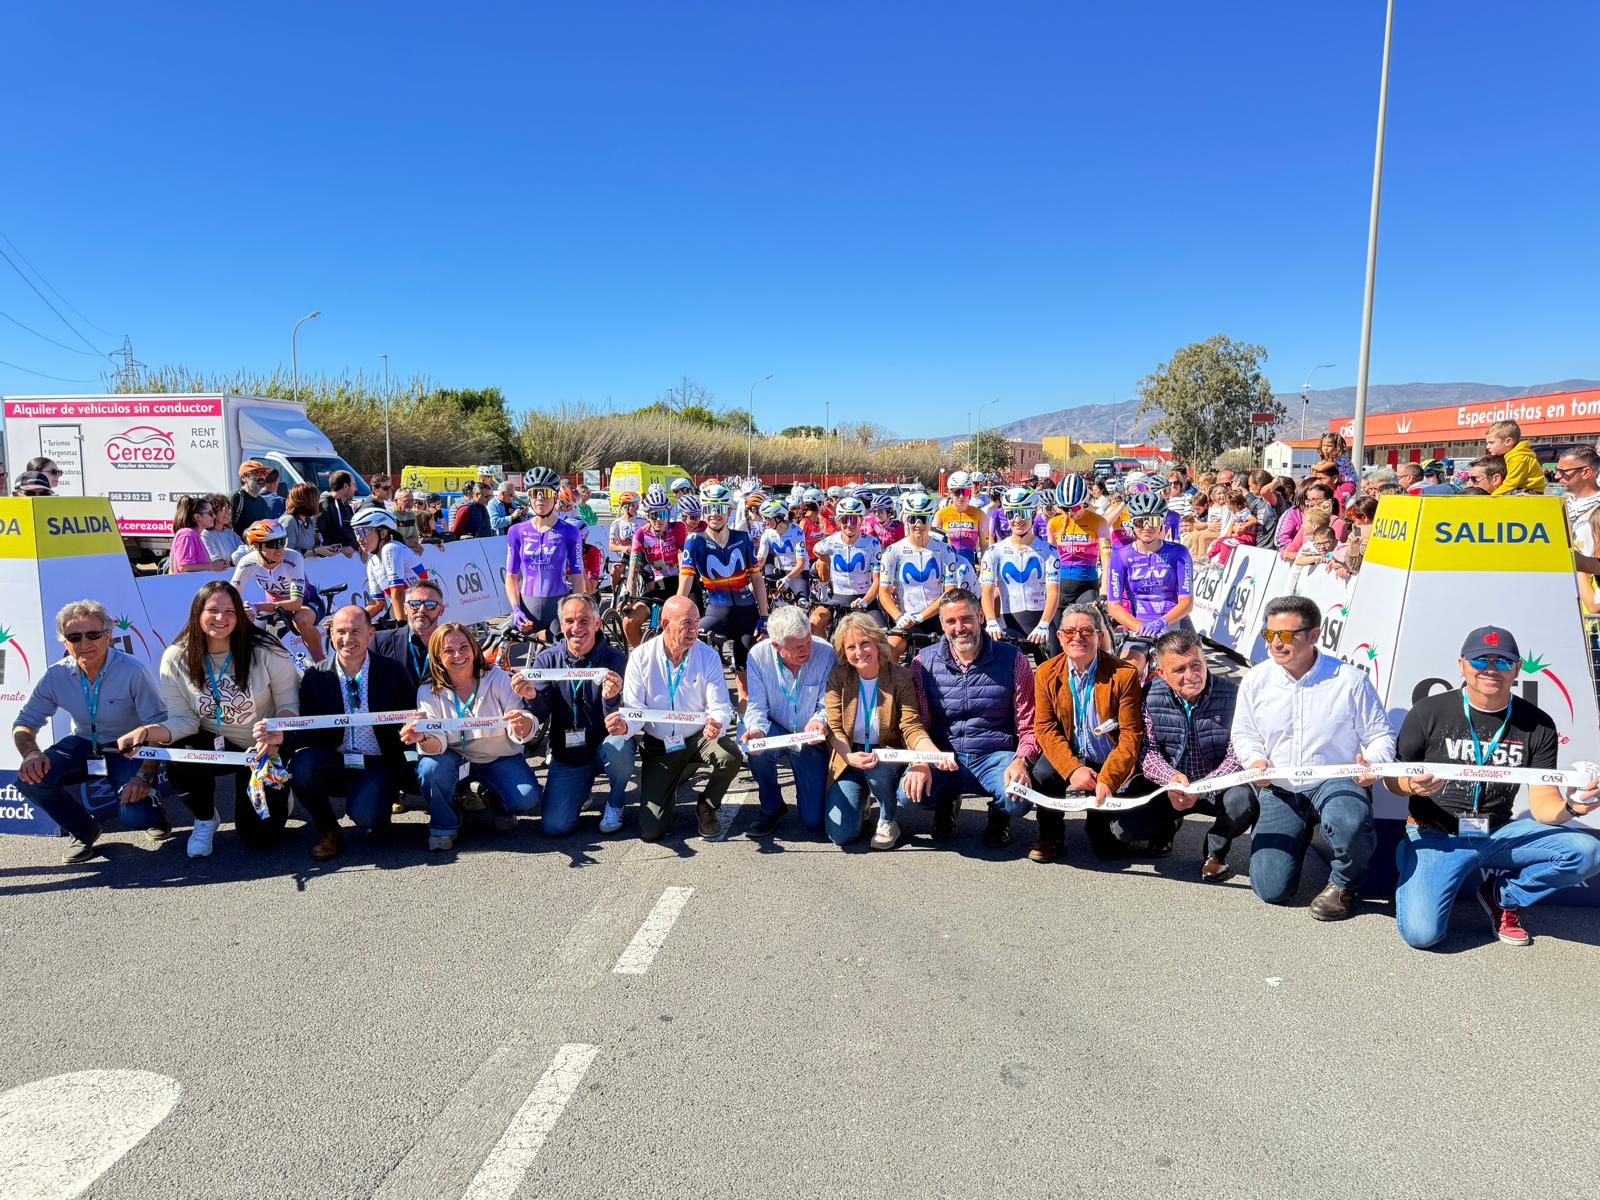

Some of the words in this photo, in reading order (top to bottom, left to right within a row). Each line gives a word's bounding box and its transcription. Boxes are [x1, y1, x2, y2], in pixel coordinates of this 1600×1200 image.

[13, 404, 57, 417] Alquiler
[60, 404, 75, 415] de
[134, 402, 150, 413] sin
[153, 402, 215, 414] conductor
[1457, 401, 1542, 428] Especialistas
[1547, 403, 1565, 418] en
[1571, 397, 1600, 416] tom
[191, 427, 217, 437] RENT
[190, 440, 197, 448] A
[199, 440, 219, 448] CAR
[48, 449, 77, 457] Furgonetas
[107, 443, 175, 461] Cerezo
[47, 516, 112, 535] SALIDA
[1373, 519, 1407, 541] SALIDA
[1434, 521, 1550, 544] SALIDA
[456, 572, 483, 595] CASI
[1182, 563, 1190, 592] Jayco
[1321, 616, 1343, 652] ASI
[334, 717, 349, 726] CASI
[426, 721, 442, 730] CASI
[139, 750, 156, 758] CASI
[1295, 769, 1313, 777] CASI
[1405, 766, 1425, 775] CASI
[1541, 774, 1563, 782] CASI
[0, 784, 25, 801] rfit
[0, 803, 34, 819] rock
